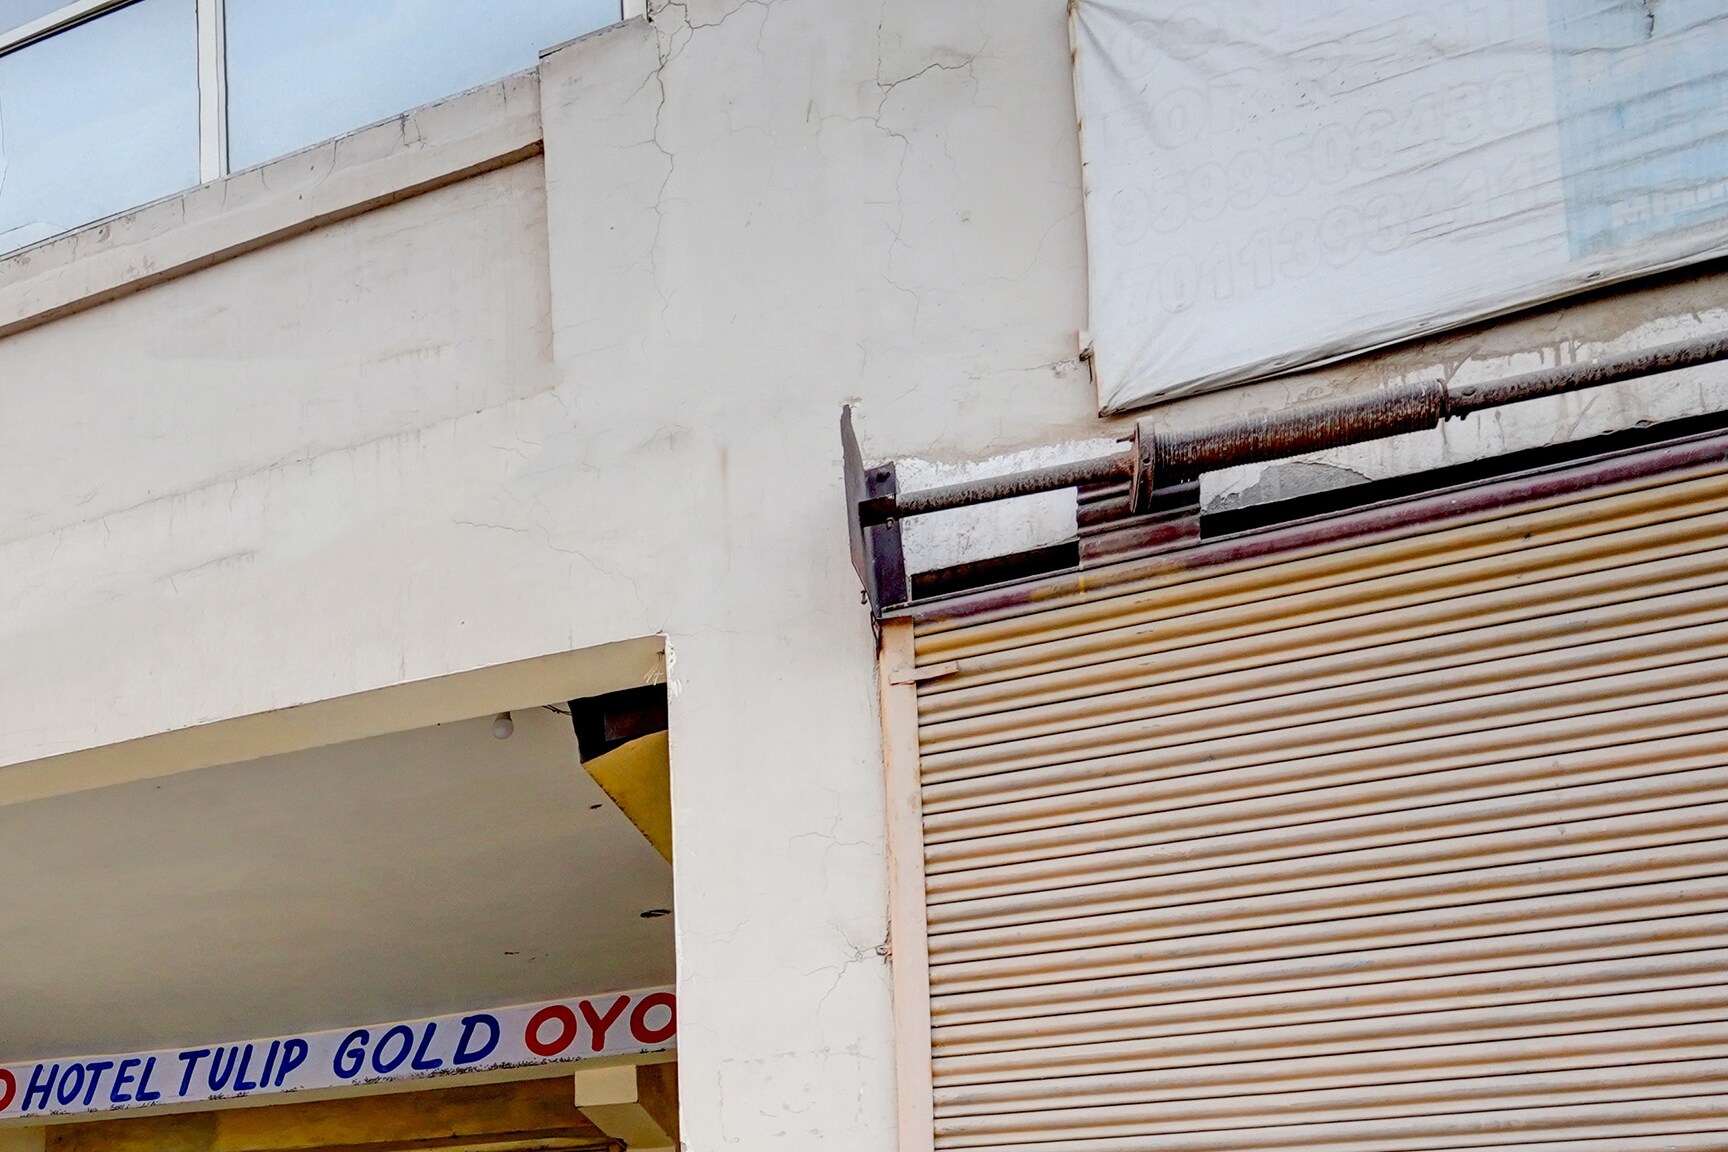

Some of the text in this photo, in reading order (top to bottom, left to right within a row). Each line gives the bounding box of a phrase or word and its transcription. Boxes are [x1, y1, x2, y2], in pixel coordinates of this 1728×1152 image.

[21, 1056, 161, 1112] HOTEL
[177, 1039, 308, 1098] TULIP
[332, 1012, 501, 1079] GOLD
[525, 992, 677, 1057] OYO
